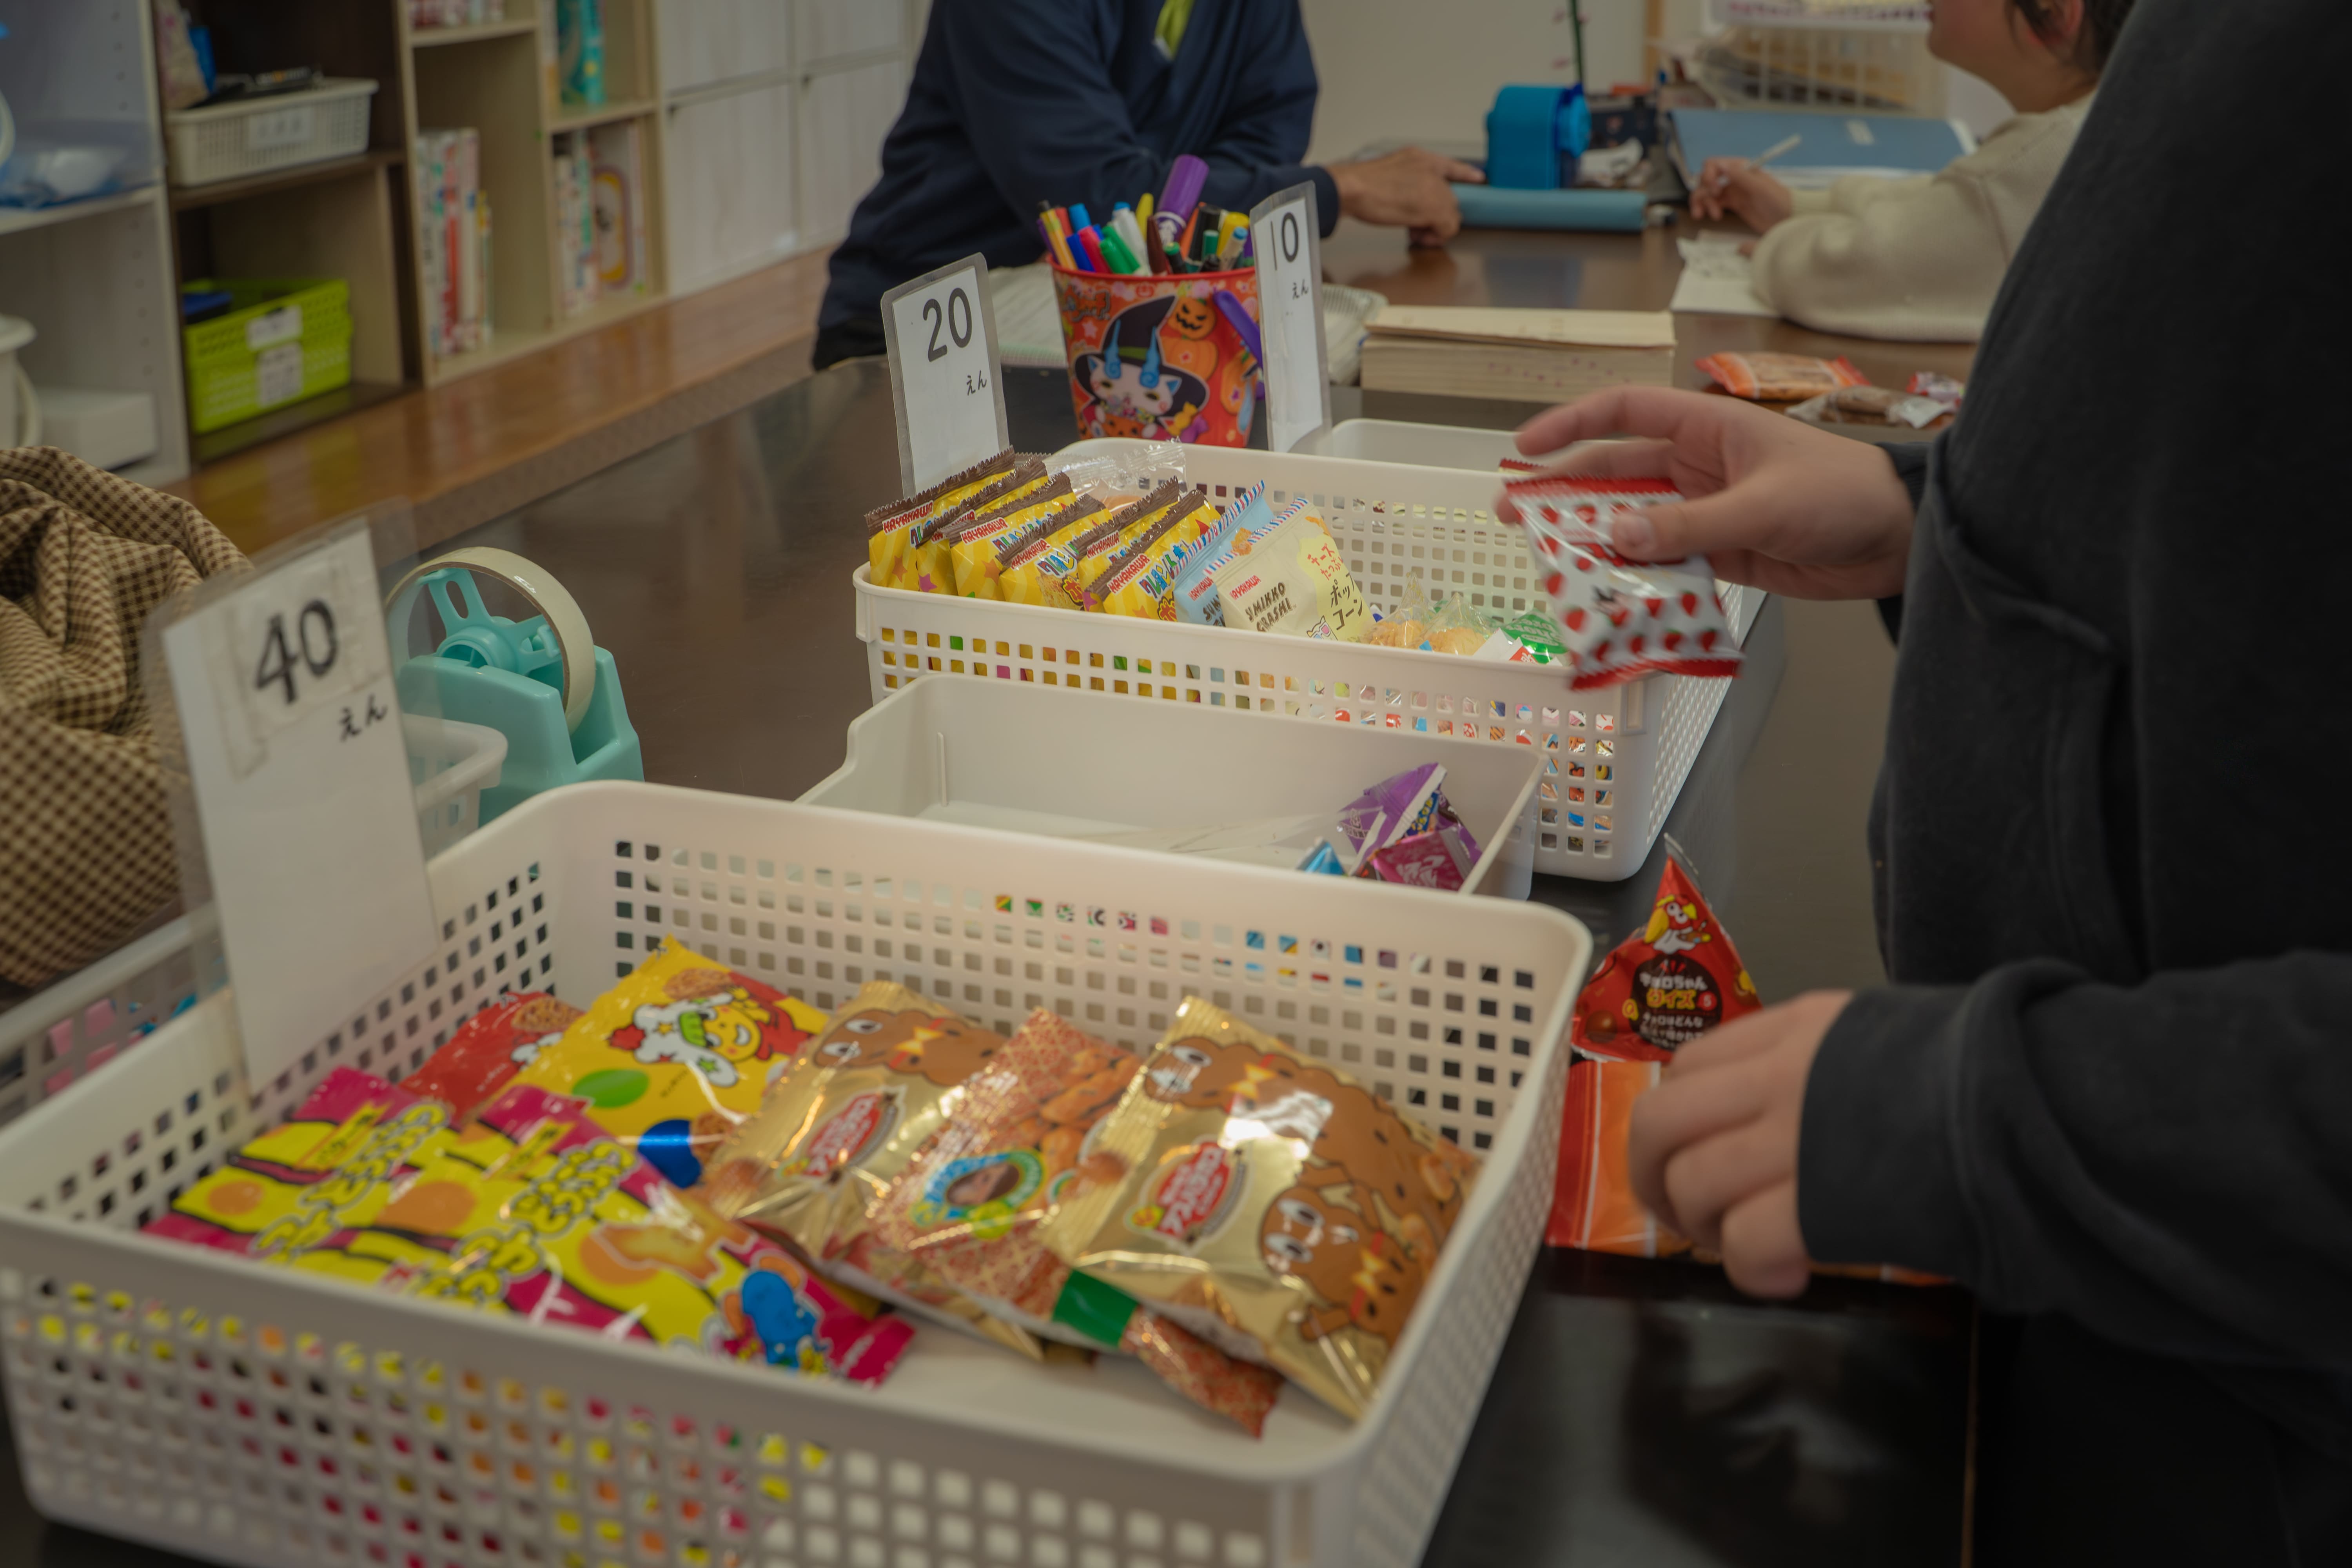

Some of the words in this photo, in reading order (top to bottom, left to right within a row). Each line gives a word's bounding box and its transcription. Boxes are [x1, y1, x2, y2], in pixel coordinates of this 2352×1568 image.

[1270, 212, 1299, 271] 10
[1292, 279, 1309, 300] えん
[923, 287, 972, 363] 20
[966, 370, 987, 396] えん
[883, 501, 933, 534] HAYAKAWA
[962, 519, 1008, 544] HAYAKAWA
[1011, 539, 1051, 570] HAYAKAWA
[1087, 533, 1120, 559] HAYAKAWA
[1108, 554, 1151, 593] HAYAKAWA
[1333, 597, 1363, 630] コーン
[254, 599, 339, 705] 40
[339, 694, 388, 742] えん
[1647, 987, 1697, 1010] クイズ
